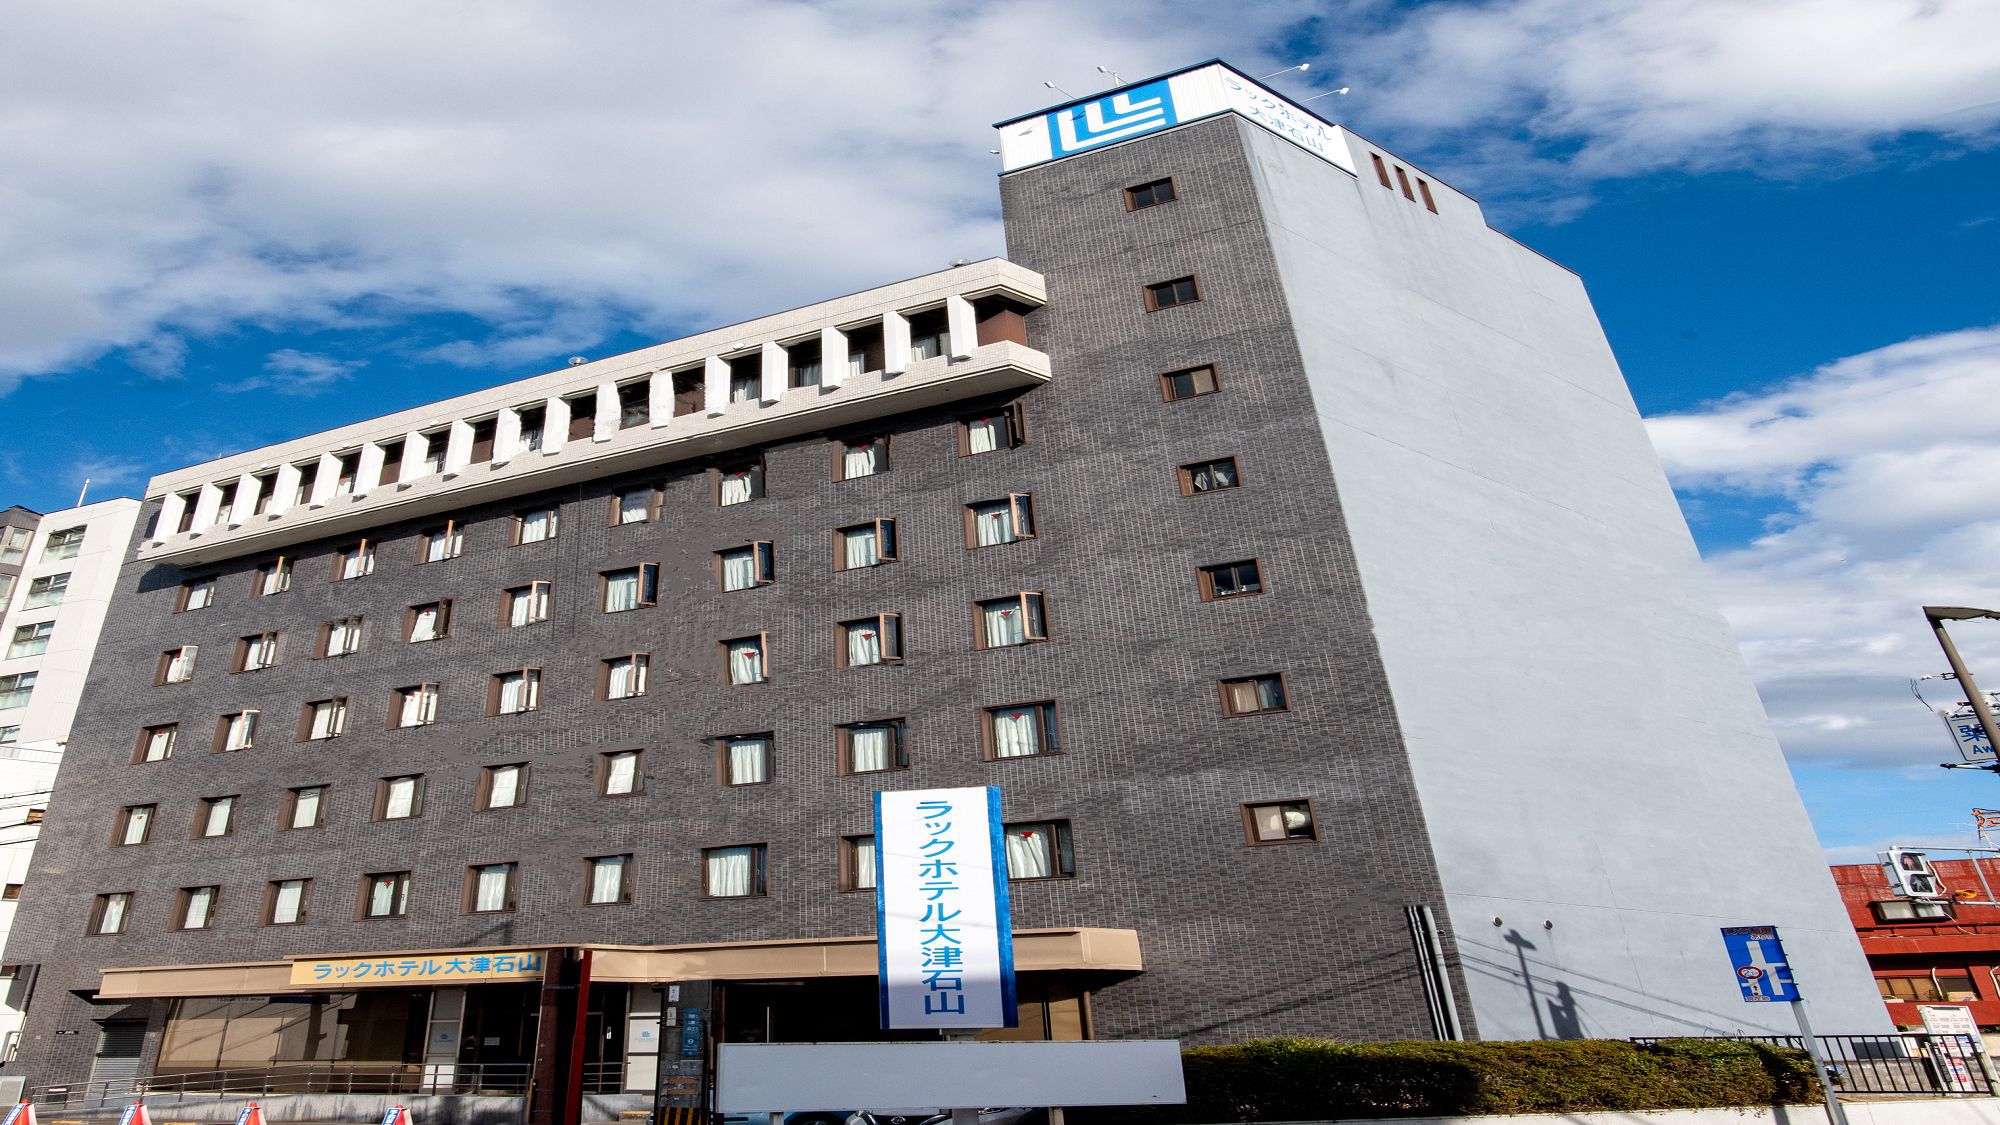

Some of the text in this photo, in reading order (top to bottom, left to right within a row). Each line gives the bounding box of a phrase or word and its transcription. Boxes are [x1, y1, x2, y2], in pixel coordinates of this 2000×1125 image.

[1225, 77, 1332, 140] ラックホテル
[1248, 105, 1323, 152] 大津石山
[915, 800, 968, 1016] ラックホテル大津石山
[313, 955, 542, 980] ラックホテル大津石山
